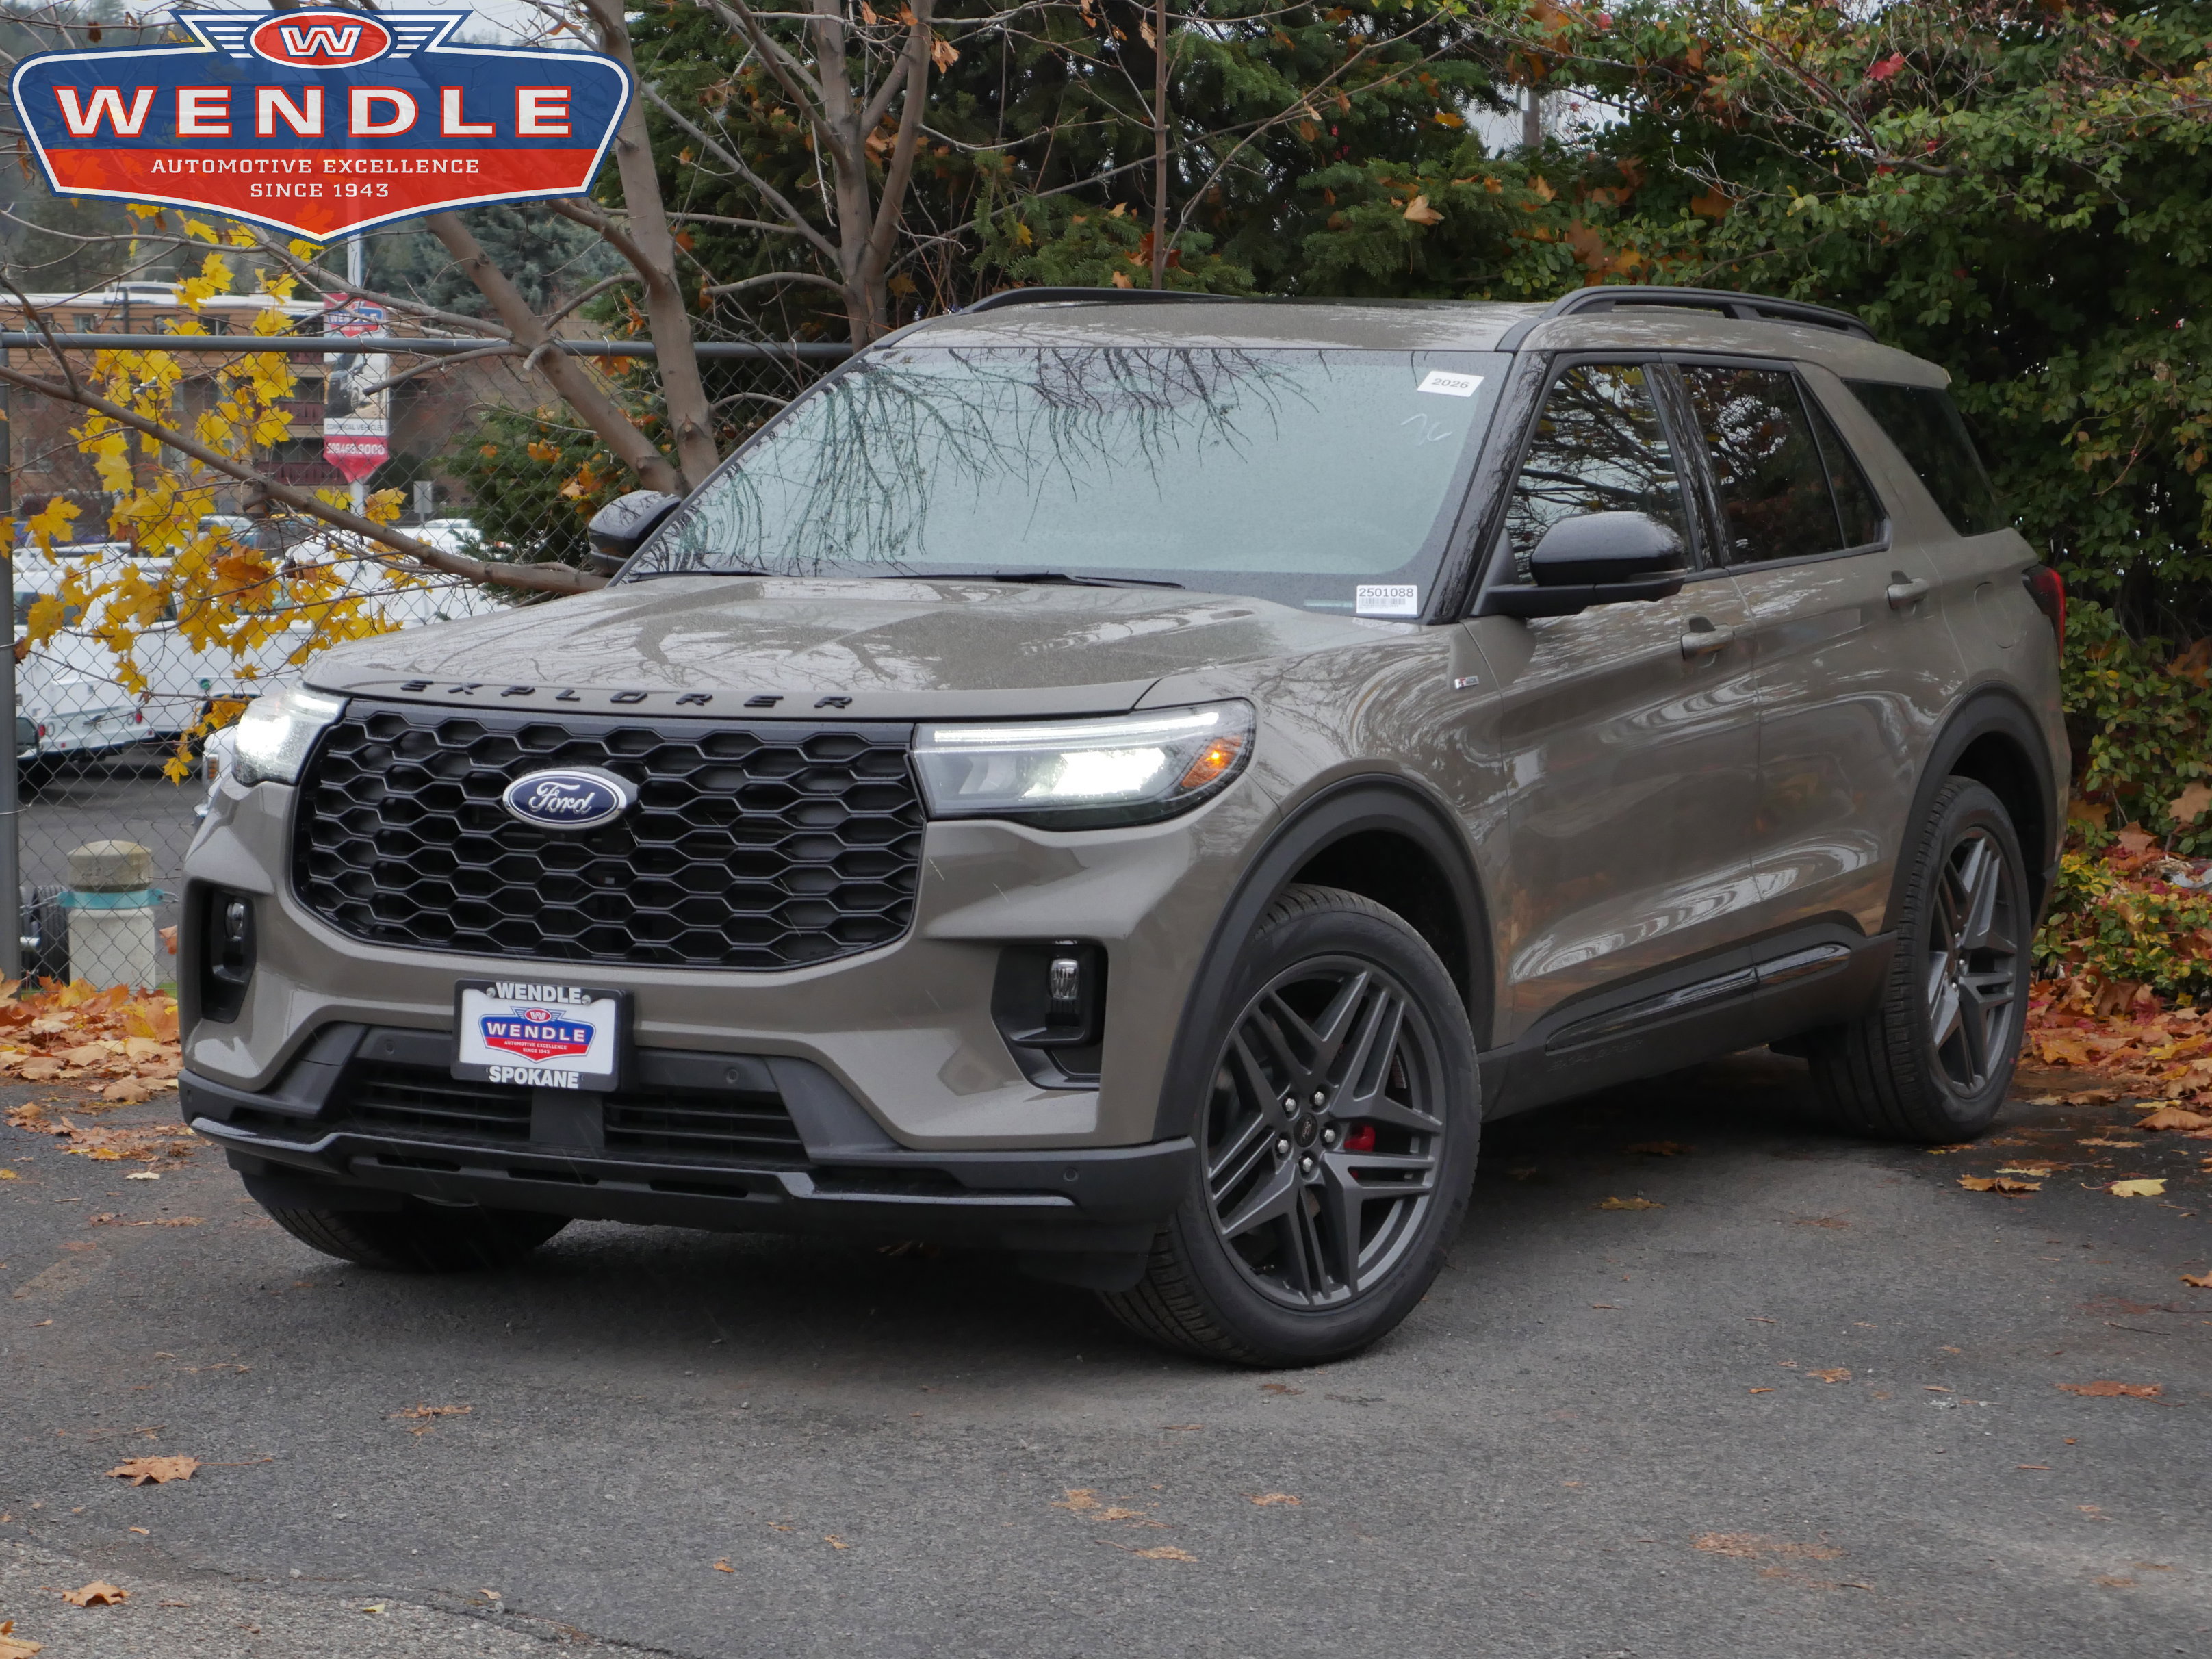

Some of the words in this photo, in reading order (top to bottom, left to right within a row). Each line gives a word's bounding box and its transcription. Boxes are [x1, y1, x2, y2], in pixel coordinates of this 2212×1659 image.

[1431, 378, 1469, 389] 2026
[1359, 587, 1414, 597] 2501088
[400, 679, 853, 709] EXPLORER
[528, 781, 595, 814] Ford
[496, 982, 582, 1004] WENDLE
[487, 1022, 584, 1042] WENDLE
[489, 1065, 579, 1089] SPOKANE
